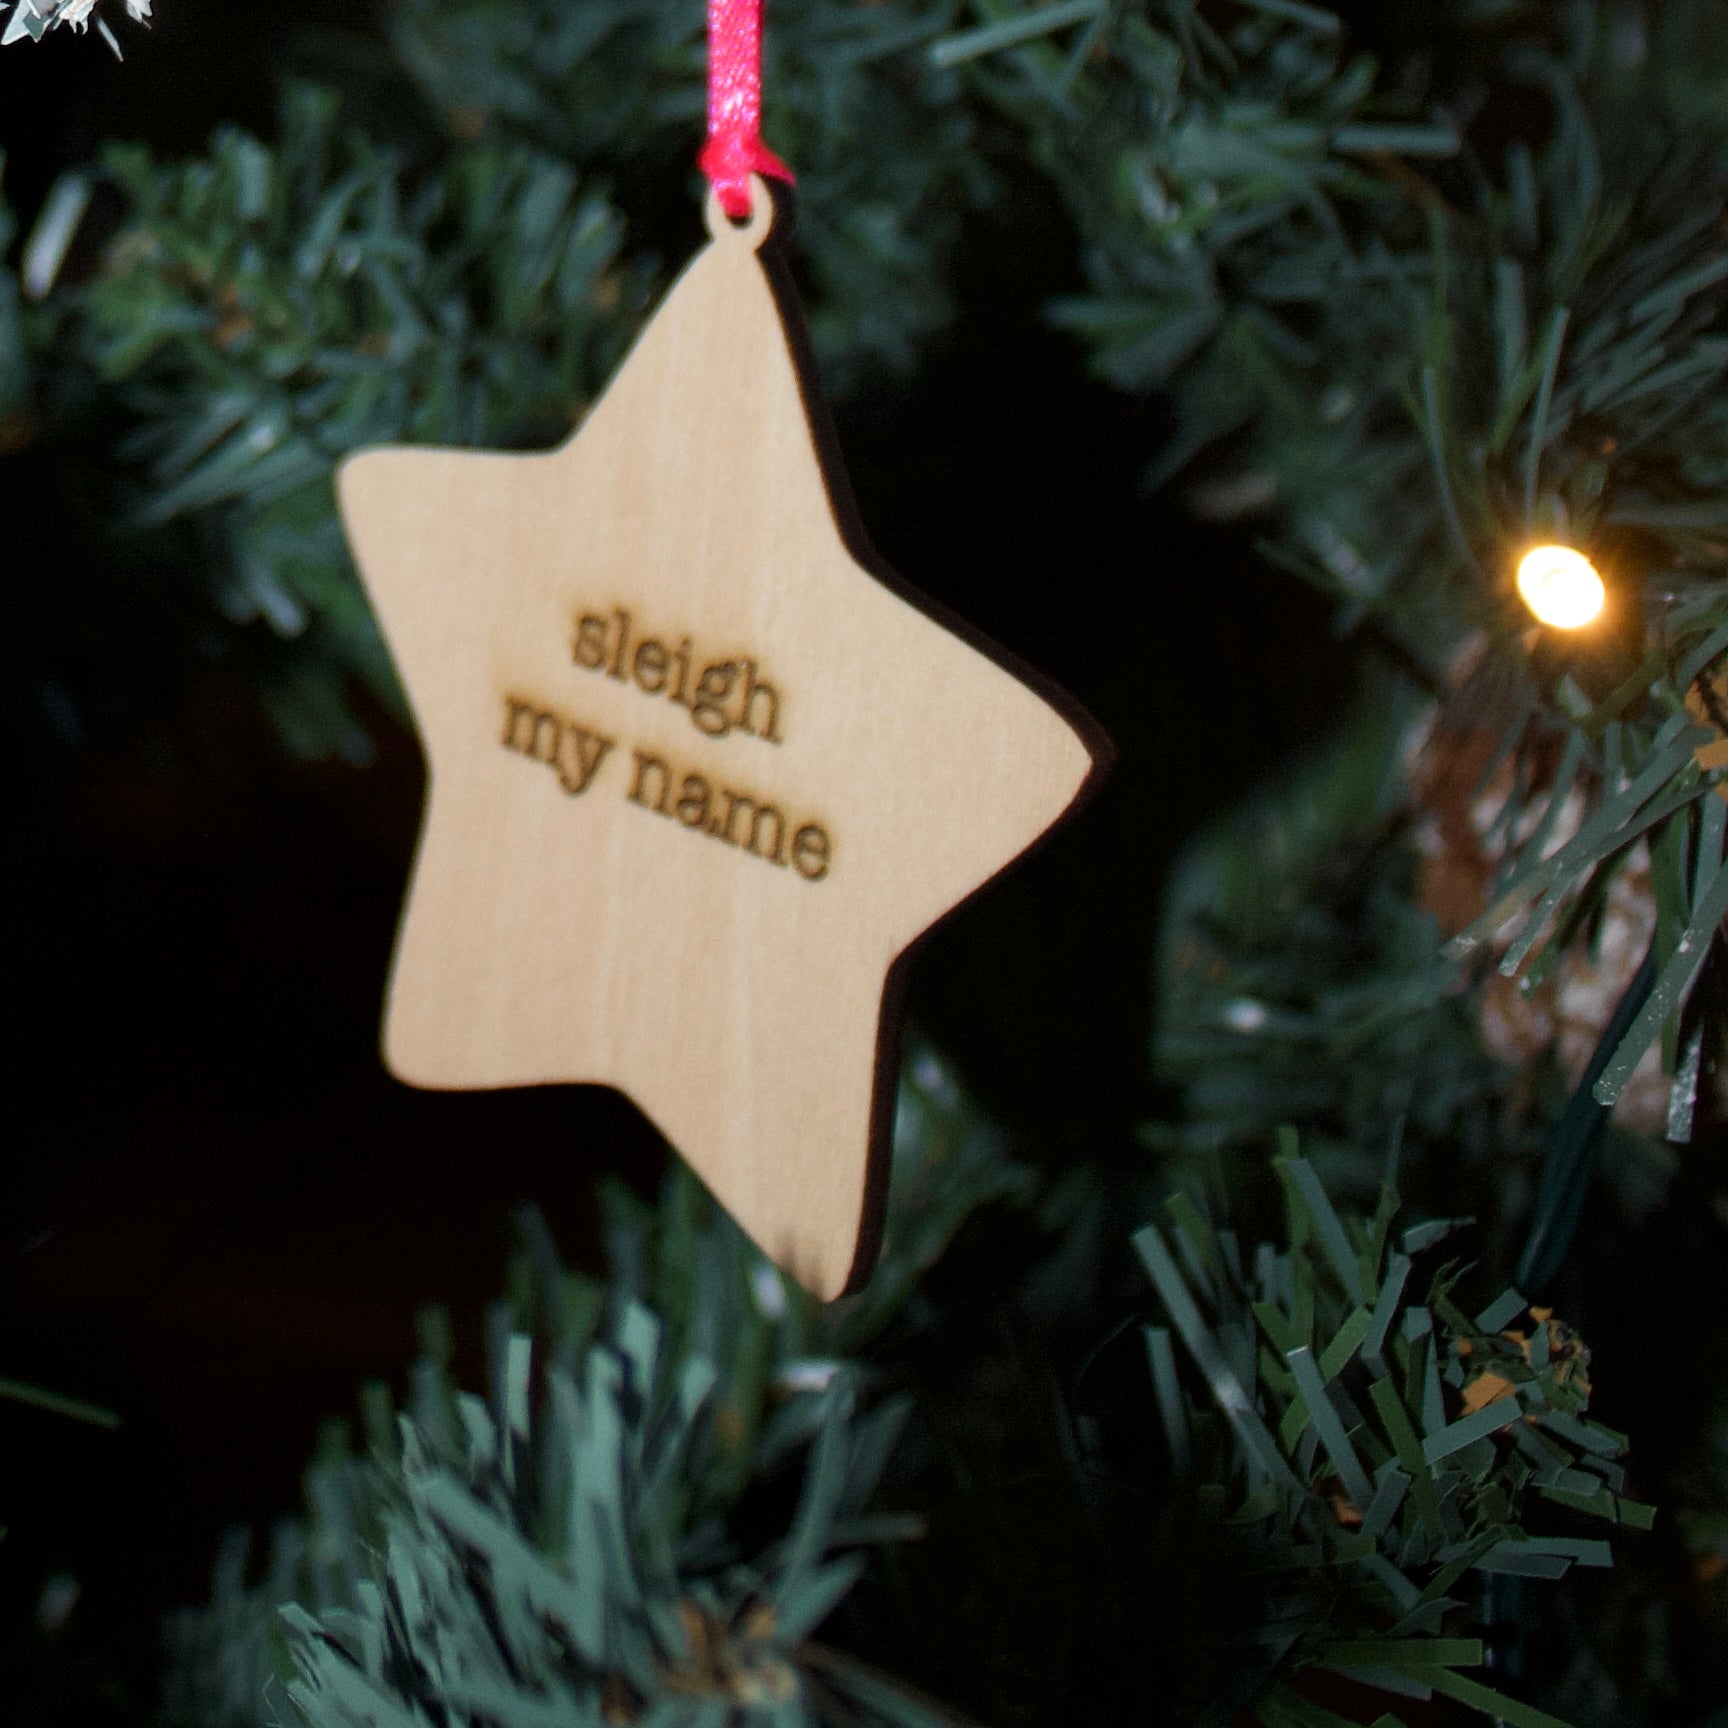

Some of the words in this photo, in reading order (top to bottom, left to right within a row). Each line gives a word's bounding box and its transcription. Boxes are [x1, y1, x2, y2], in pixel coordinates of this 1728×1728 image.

[573, 606, 783, 745] sleigh
[501, 694, 616, 797] my
[627, 747, 831, 882] name
